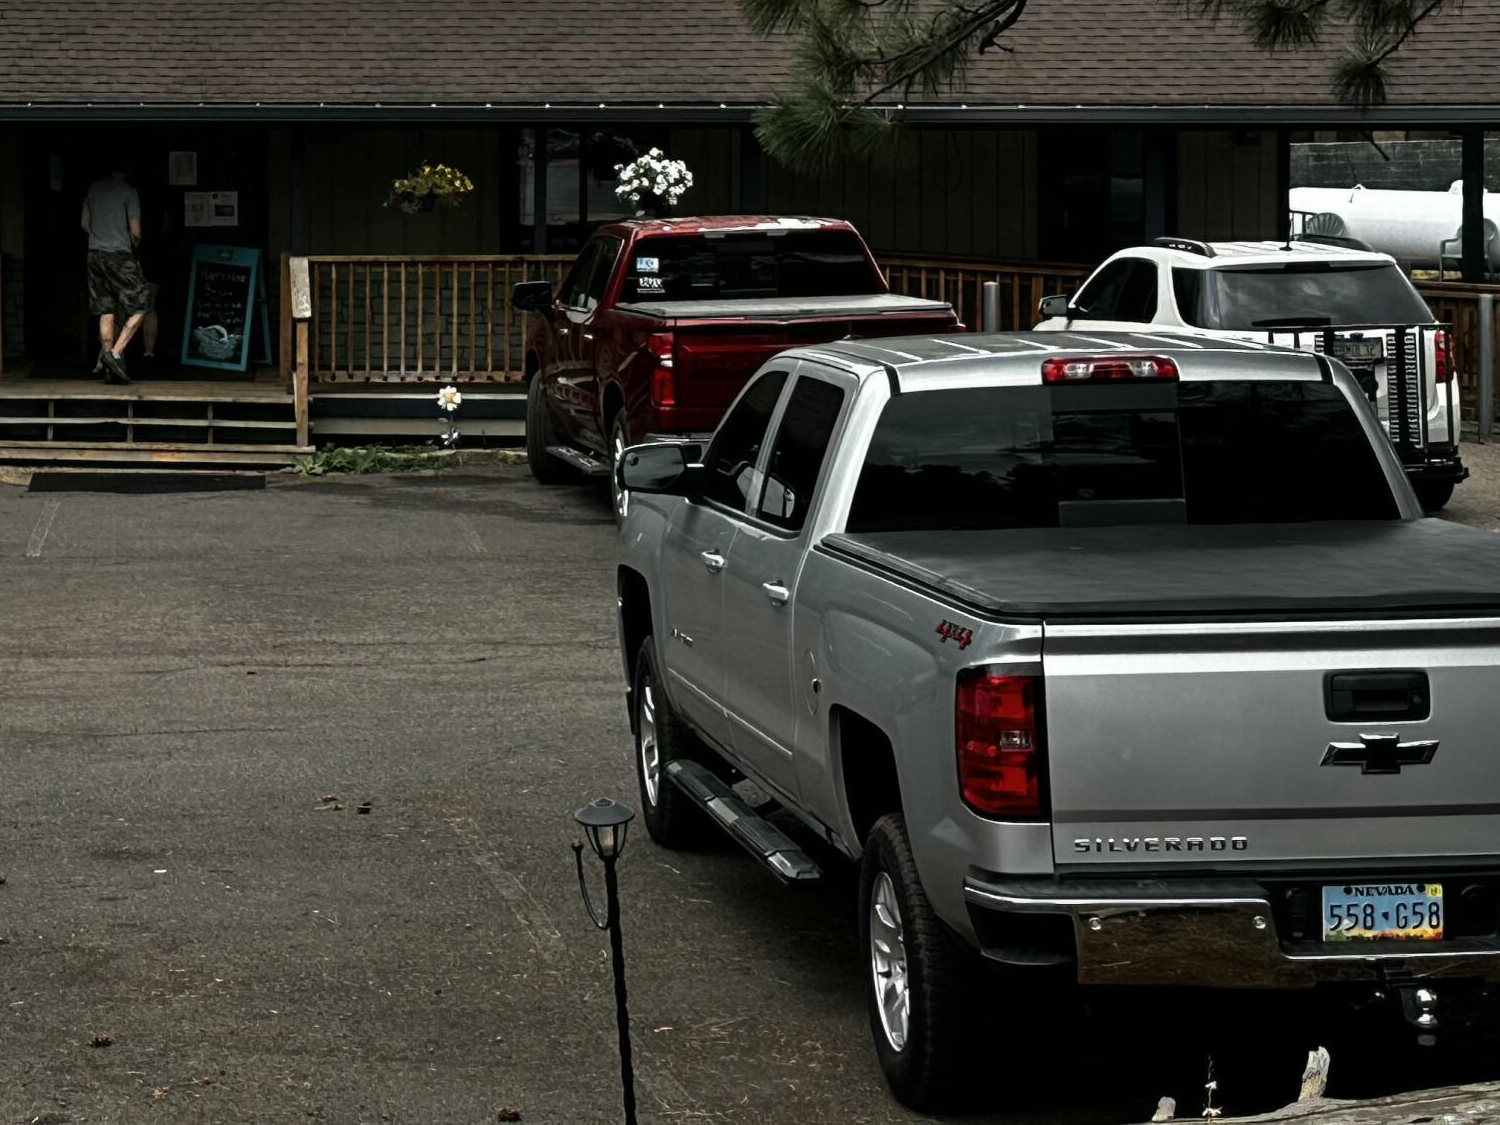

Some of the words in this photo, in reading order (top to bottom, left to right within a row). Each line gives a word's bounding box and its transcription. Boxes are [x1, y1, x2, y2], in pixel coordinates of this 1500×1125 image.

[1074, 836, 1249, 853] SILVERADO
[1354, 885, 1415, 897] NEVADA
[1329, 903, 1375, 931] 558
[1395, 901, 1440, 930] G58
